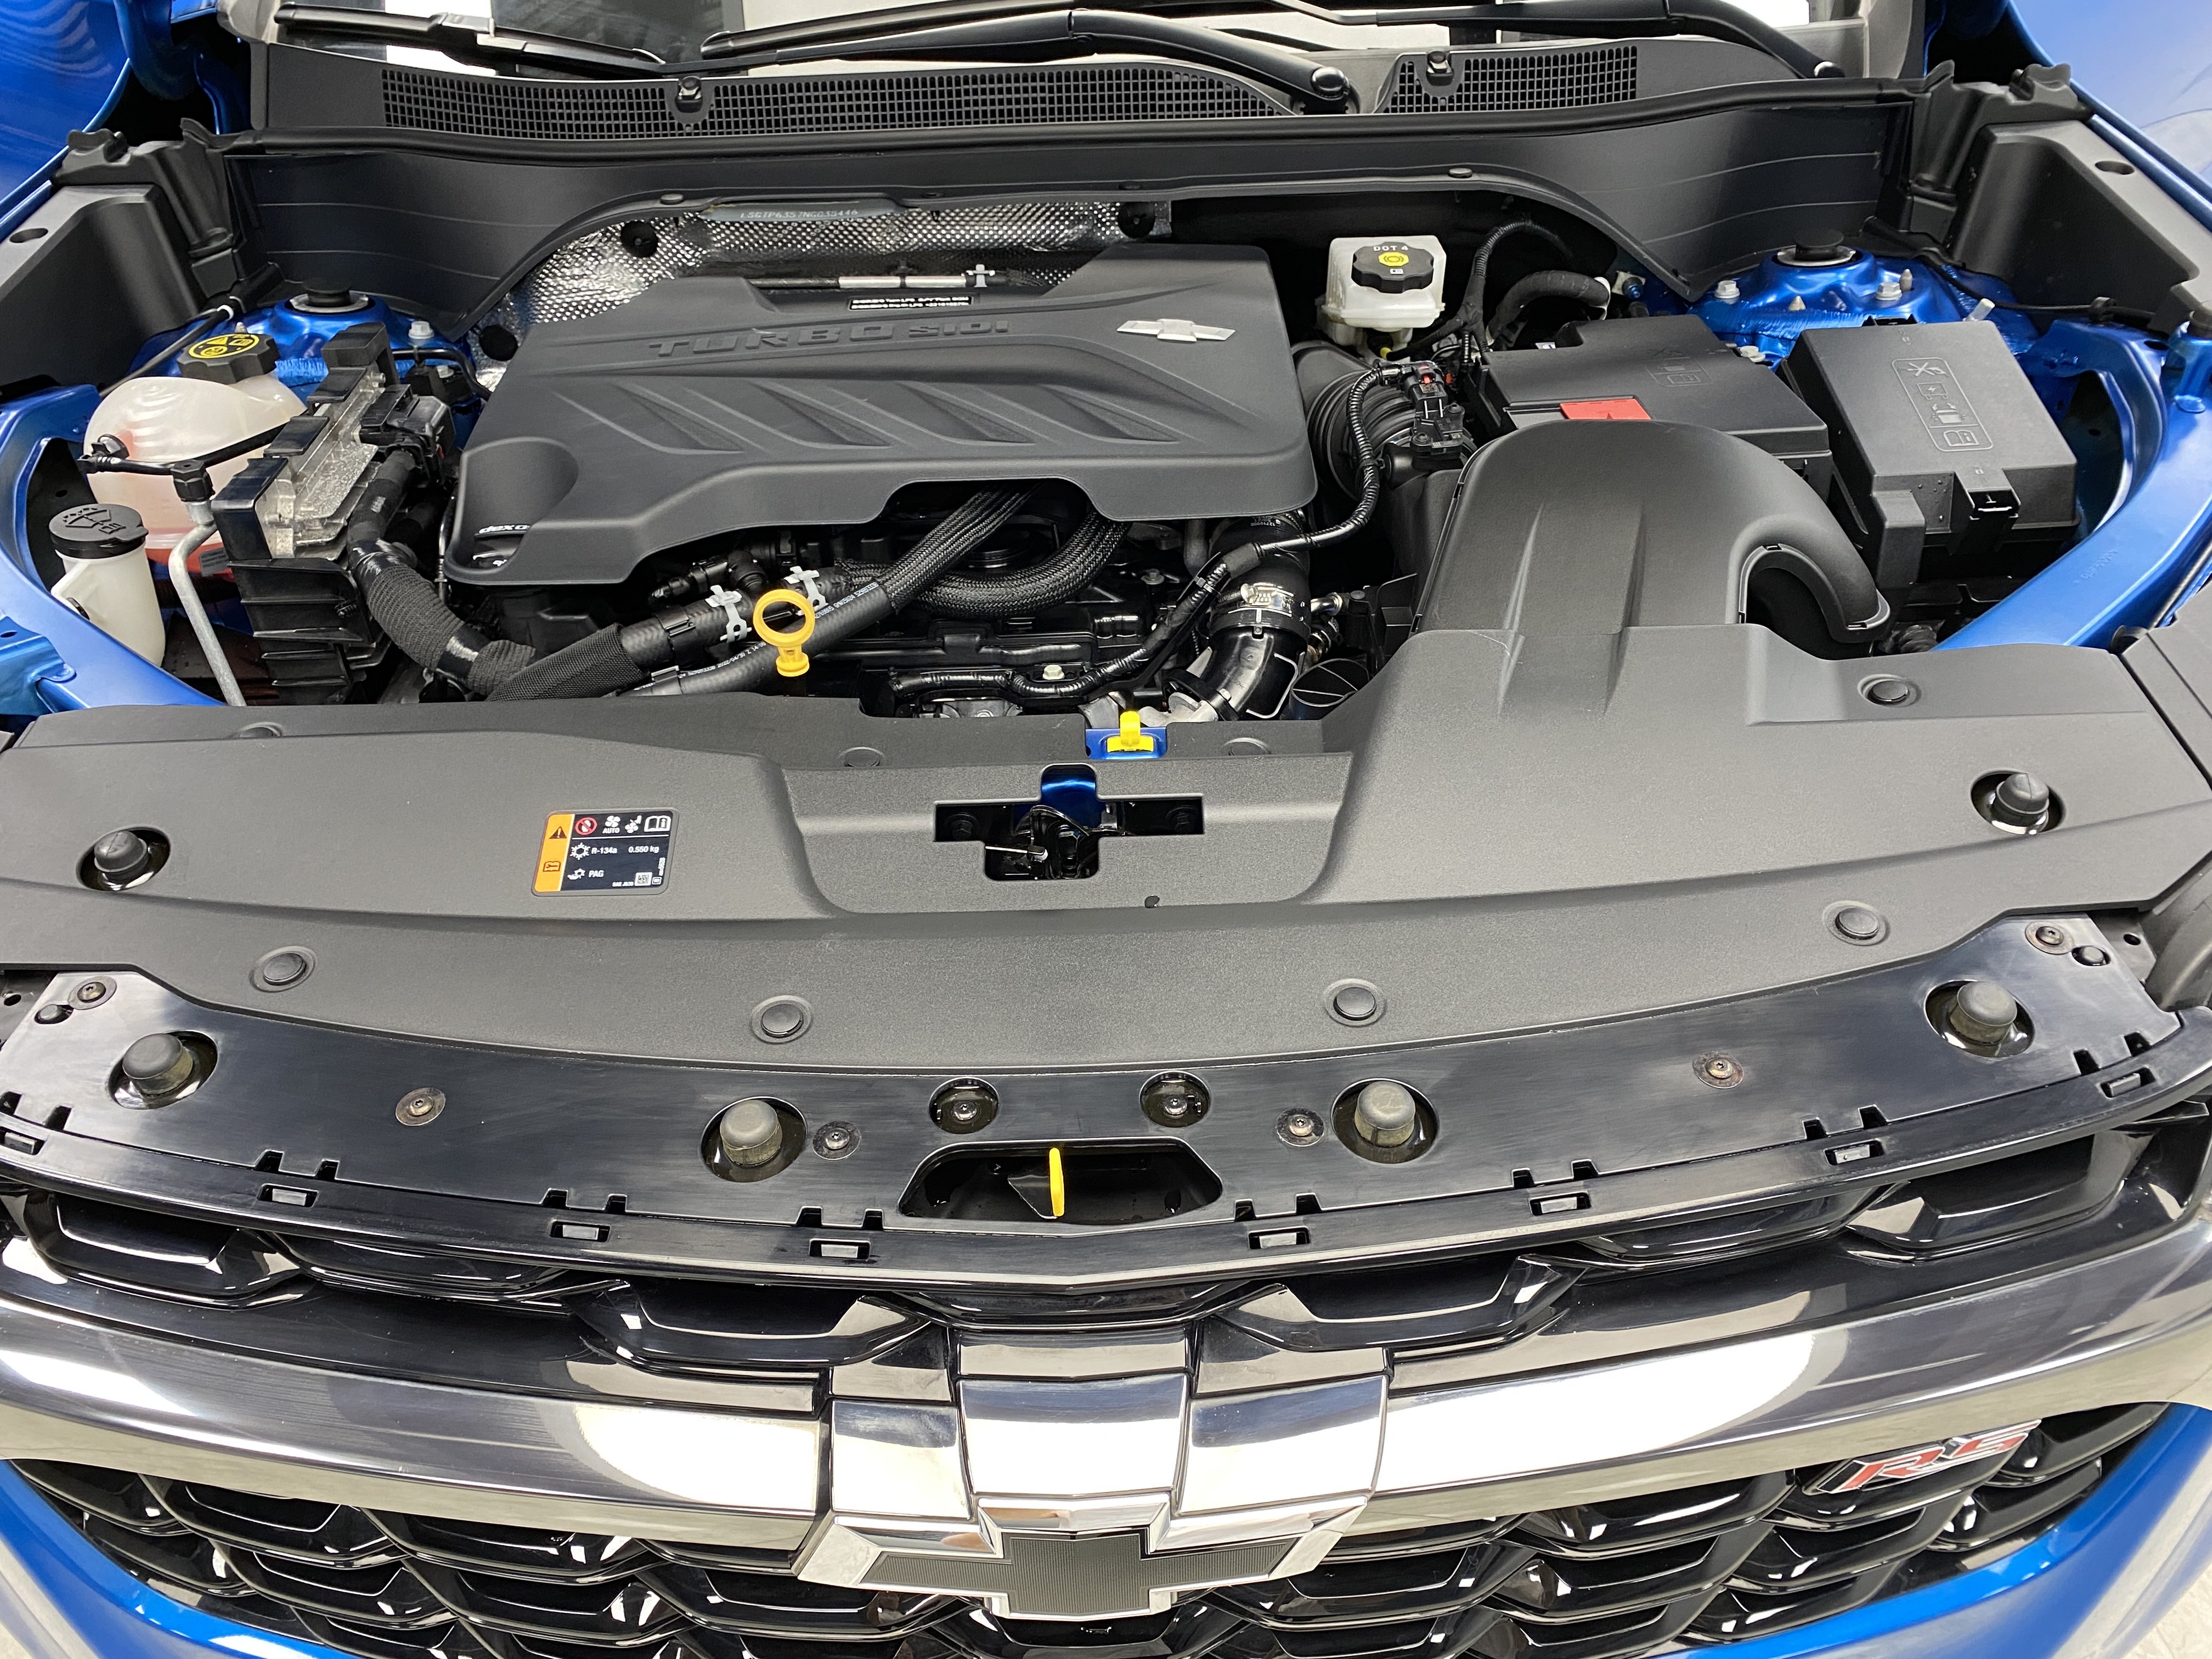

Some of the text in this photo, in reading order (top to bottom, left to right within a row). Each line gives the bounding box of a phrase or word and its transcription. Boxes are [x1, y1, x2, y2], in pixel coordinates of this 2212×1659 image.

[649, 320, 1008, 357] TURBO SIDI
[1817, 1419, 2042, 1494] RS
